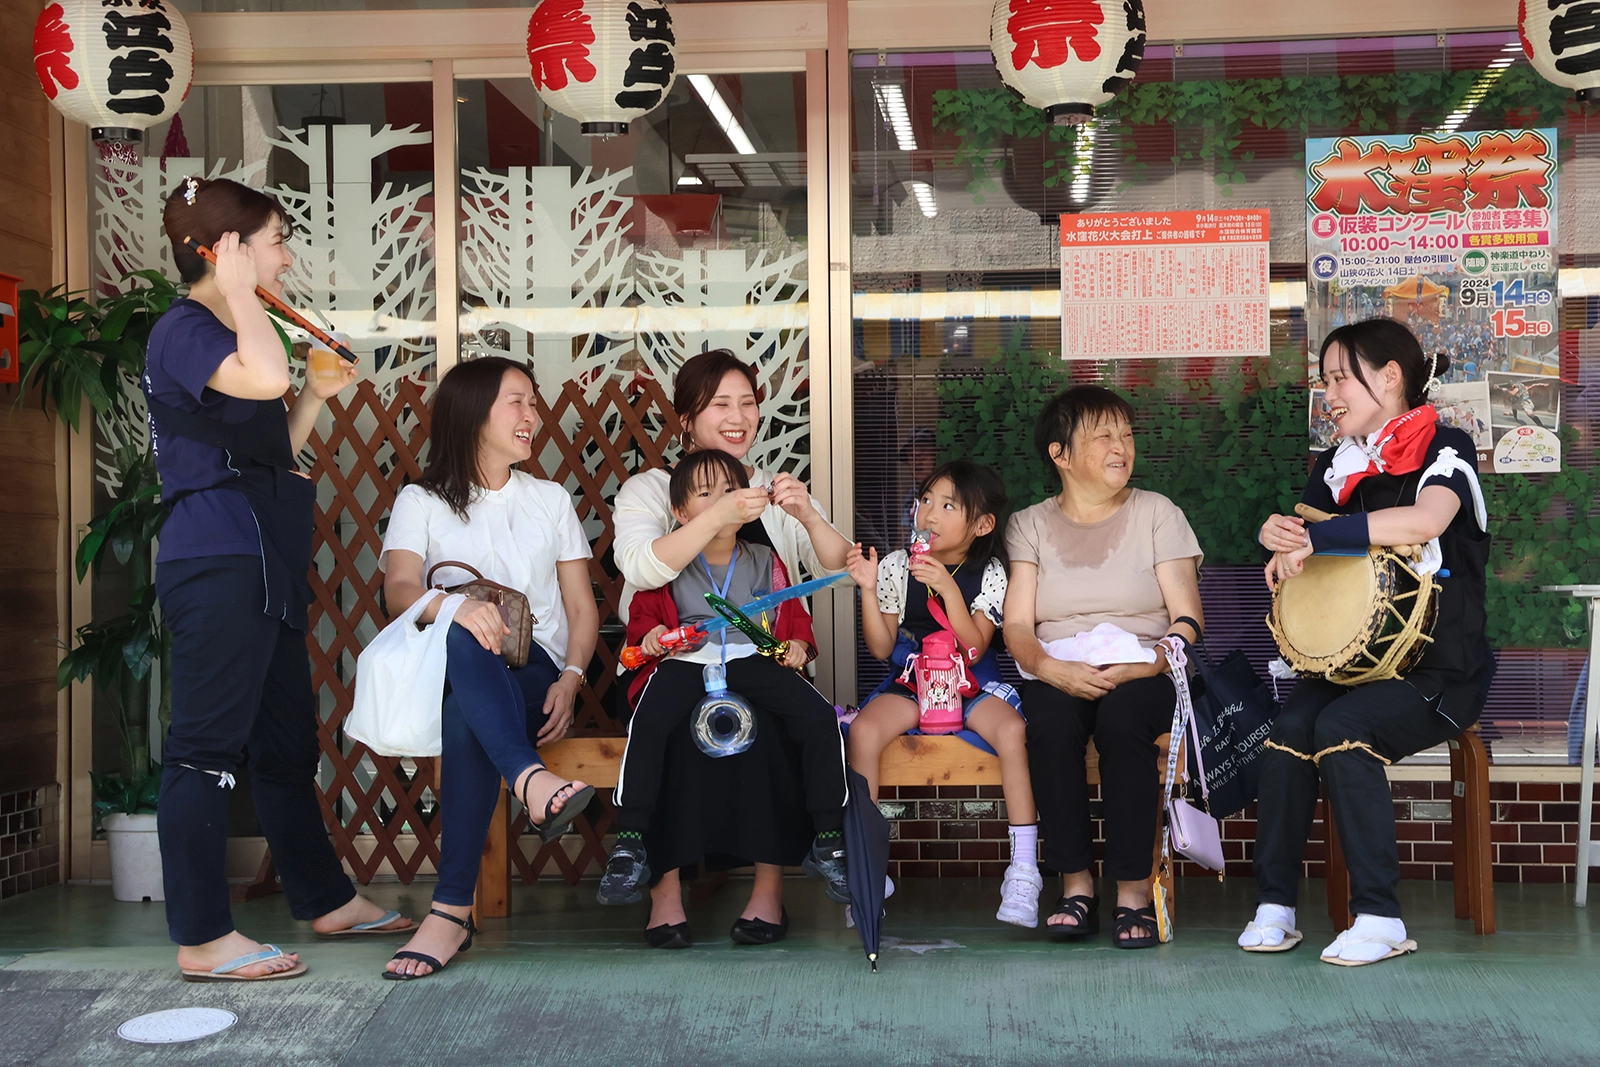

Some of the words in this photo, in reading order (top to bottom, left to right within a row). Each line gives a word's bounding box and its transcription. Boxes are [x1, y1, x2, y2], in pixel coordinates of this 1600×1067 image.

[1311, 132, 1554, 215] 水窪祭
[1076, 216, 1172, 228] ありがとうございました
[1339, 214, 1464, 235] 仮装コンクール
[1066, 229, 1153, 242] 水窪花火大会打上
[1469, 233, 1539, 246] 各賞多数用意
[1530, 262, 1547, 271] etc
[1462, 279, 1490, 288] 2024
[1461, 288, 1489, 306] 9月
